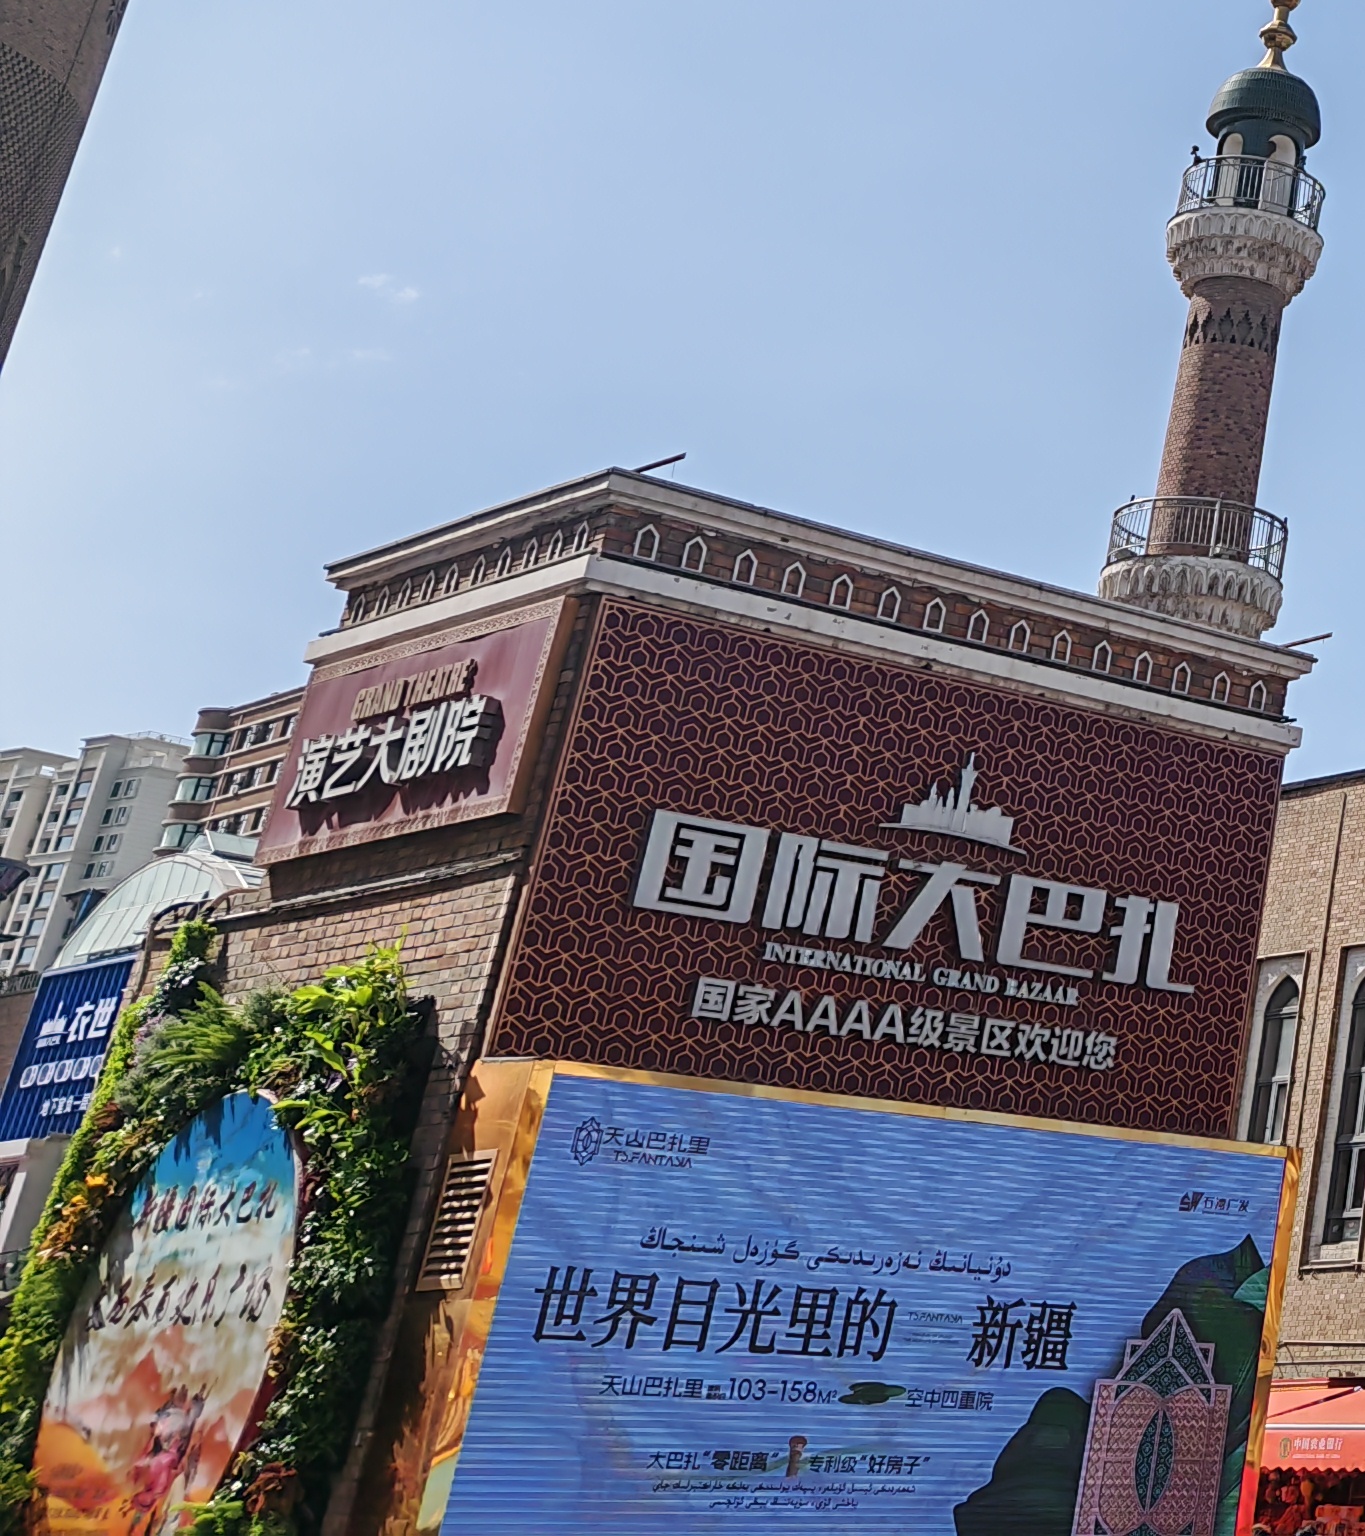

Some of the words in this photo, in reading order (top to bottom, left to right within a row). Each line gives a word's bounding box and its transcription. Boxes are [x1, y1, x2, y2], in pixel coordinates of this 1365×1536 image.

[352, 677, 405, 721] GRAND
[403, 661, 469, 707] THEATRE
[284, 694, 488, 809] 演艺大剧院
[633, 808, 1195, 994] 国际大巴扎
[762, 941, 926, 982] INTERNATIONAL
[932, 966, 999, 994] GRAND
[1003, 978, 1080, 1006] BAZAAR
[691, 979, 1118, 1071] 国家AAAA级景区欢迎您
[603, 1126, 711, 1155] 天山巴扎里
[531, 1265, 899, 1363] 世界目光里的
[966, 1294, 1078, 1371] 新疆
[599, 1374, 703, 1399] 天山巴扎里
[905, 1388, 994, 1411] 空中四重院
